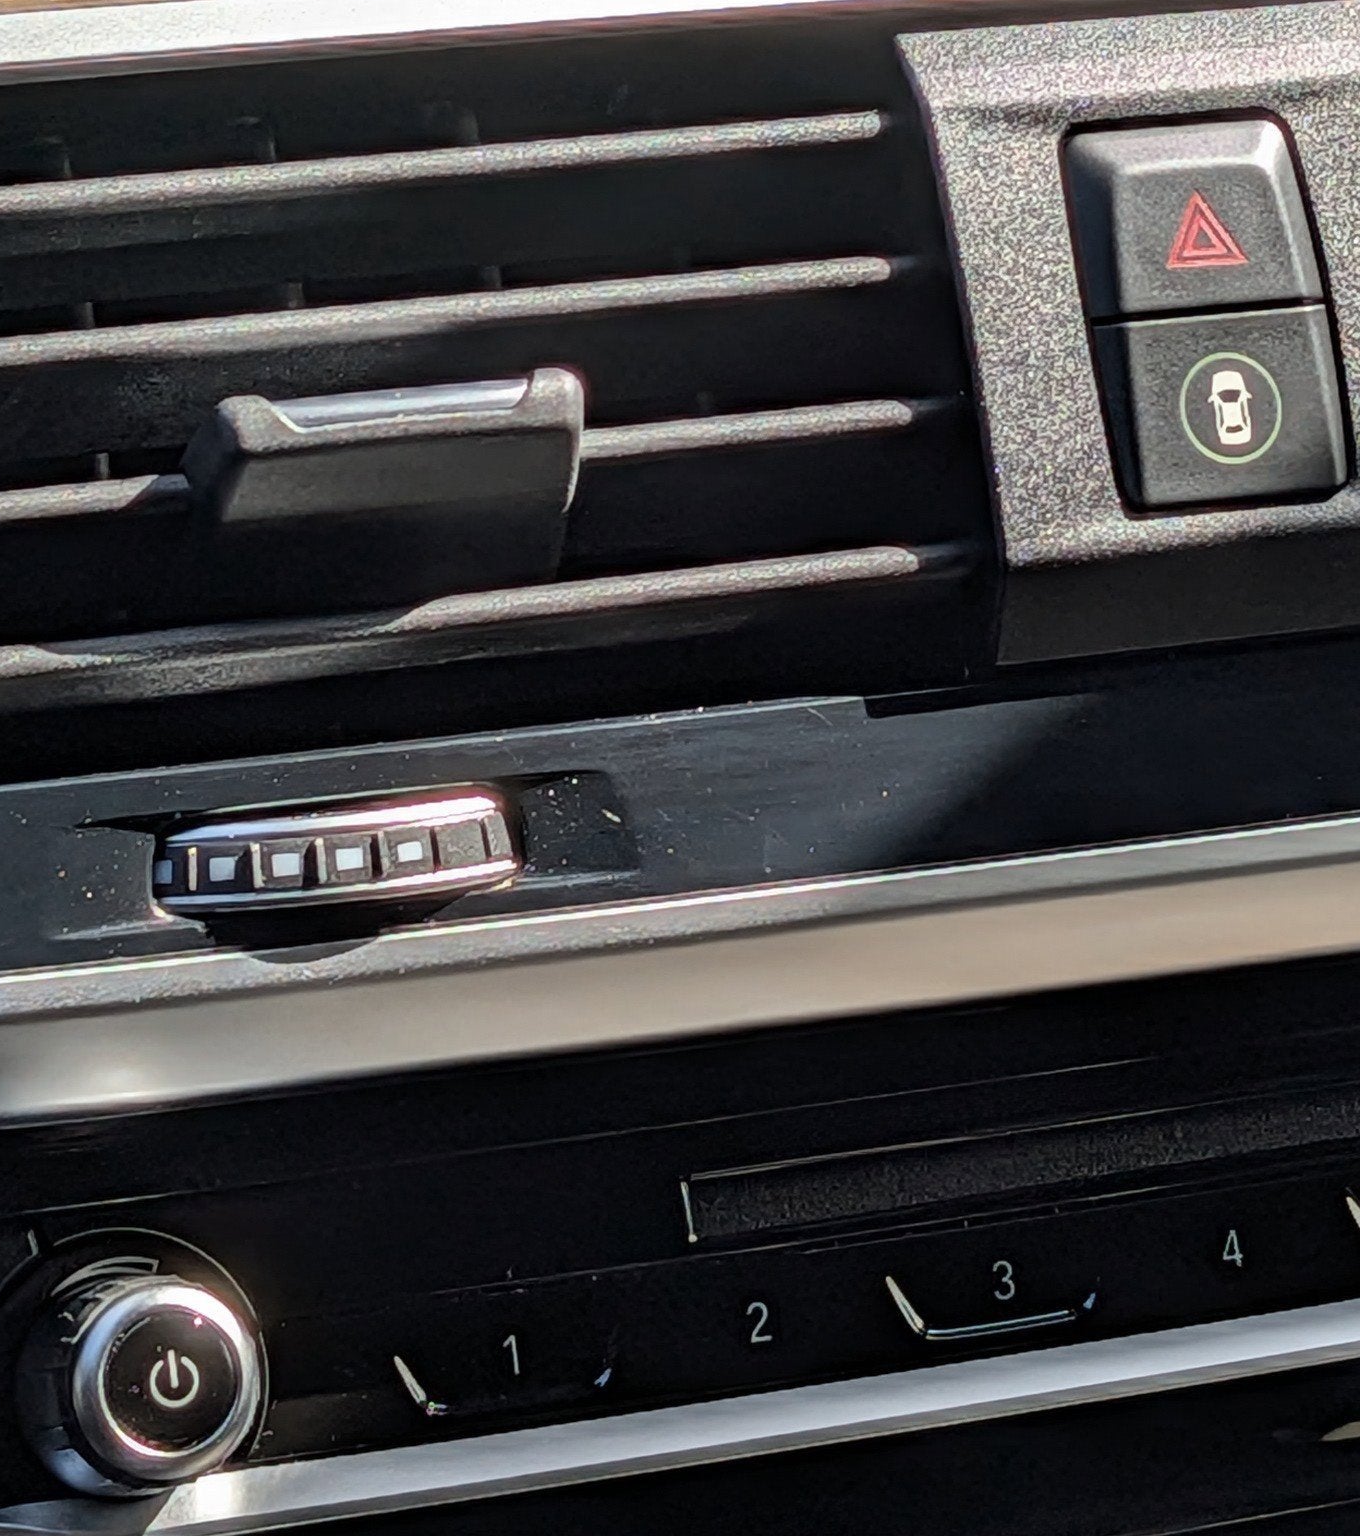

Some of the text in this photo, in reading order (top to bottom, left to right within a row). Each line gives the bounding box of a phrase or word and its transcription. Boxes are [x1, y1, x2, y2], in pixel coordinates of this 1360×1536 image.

[502, 1335, 519, 1376] 1
[749, 1302, 770, 1344] 2
[993, 1262, 1015, 1301] 3
[1222, 1230, 1243, 1267] 4
